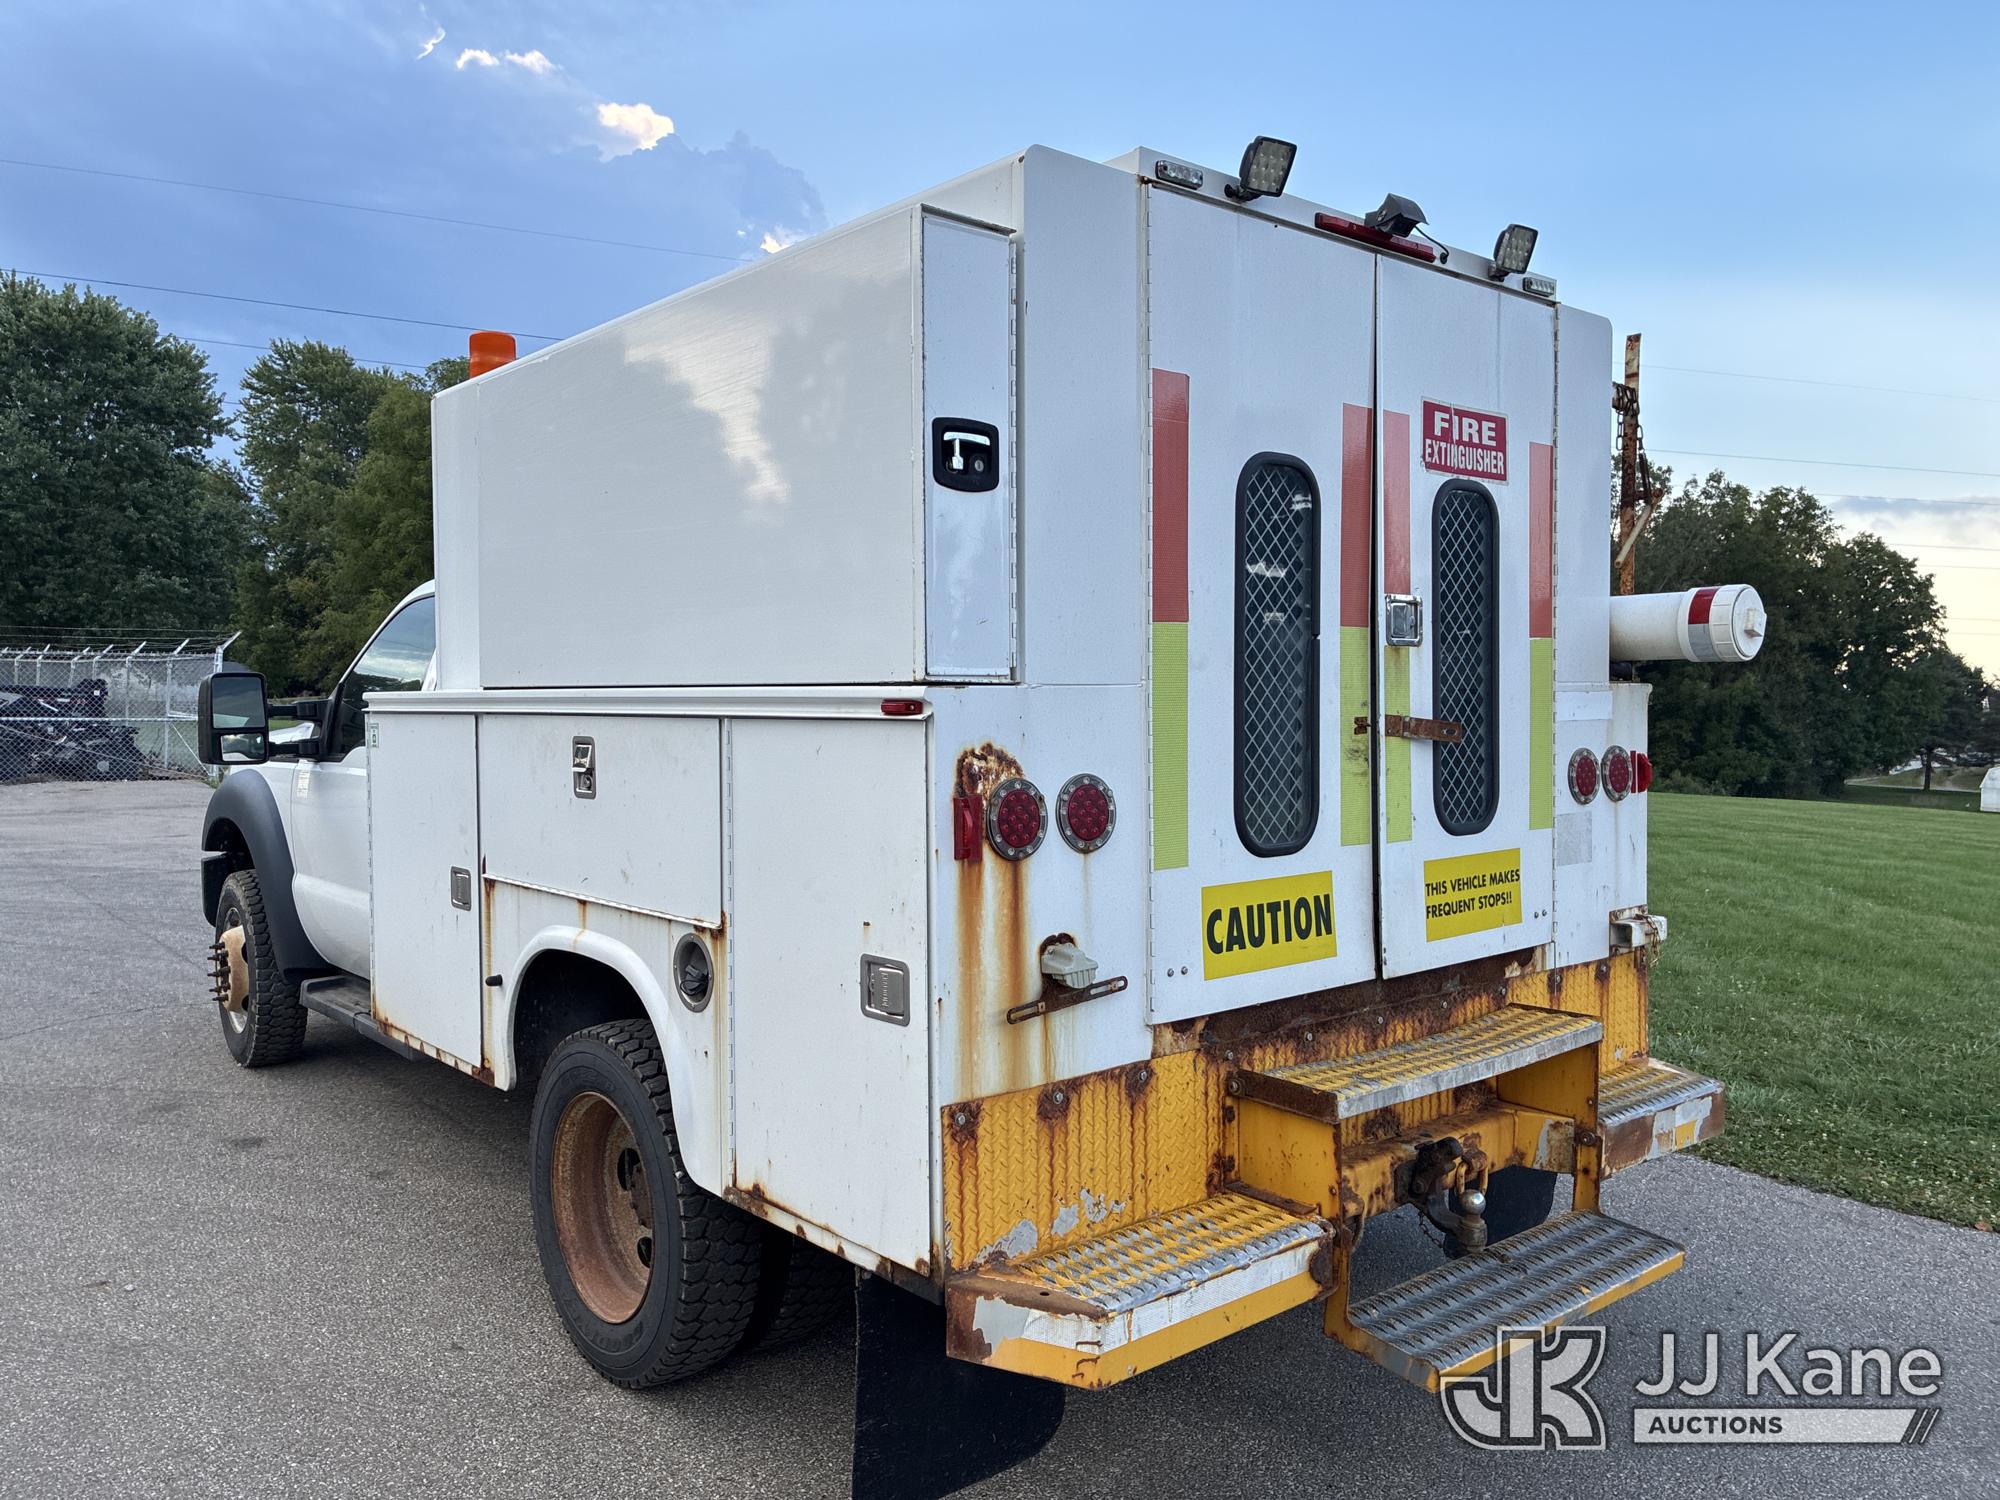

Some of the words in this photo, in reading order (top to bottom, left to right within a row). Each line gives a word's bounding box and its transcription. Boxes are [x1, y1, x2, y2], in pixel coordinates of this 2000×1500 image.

[1433, 410, 1497, 447] FIRE
[1425, 438, 1505, 475] EXTINGUISHER
[1425, 880, 1448, 897] THIS
[1450, 874, 1487, 892] VEHICLE
[1489, 868, 1521, 886] MAKES
[1426, 898, 1476, 919] FREQUENT
[1478, 891, 1512, 910] STOPS!!
[1206, 893, 1333, 955] CAUTION
